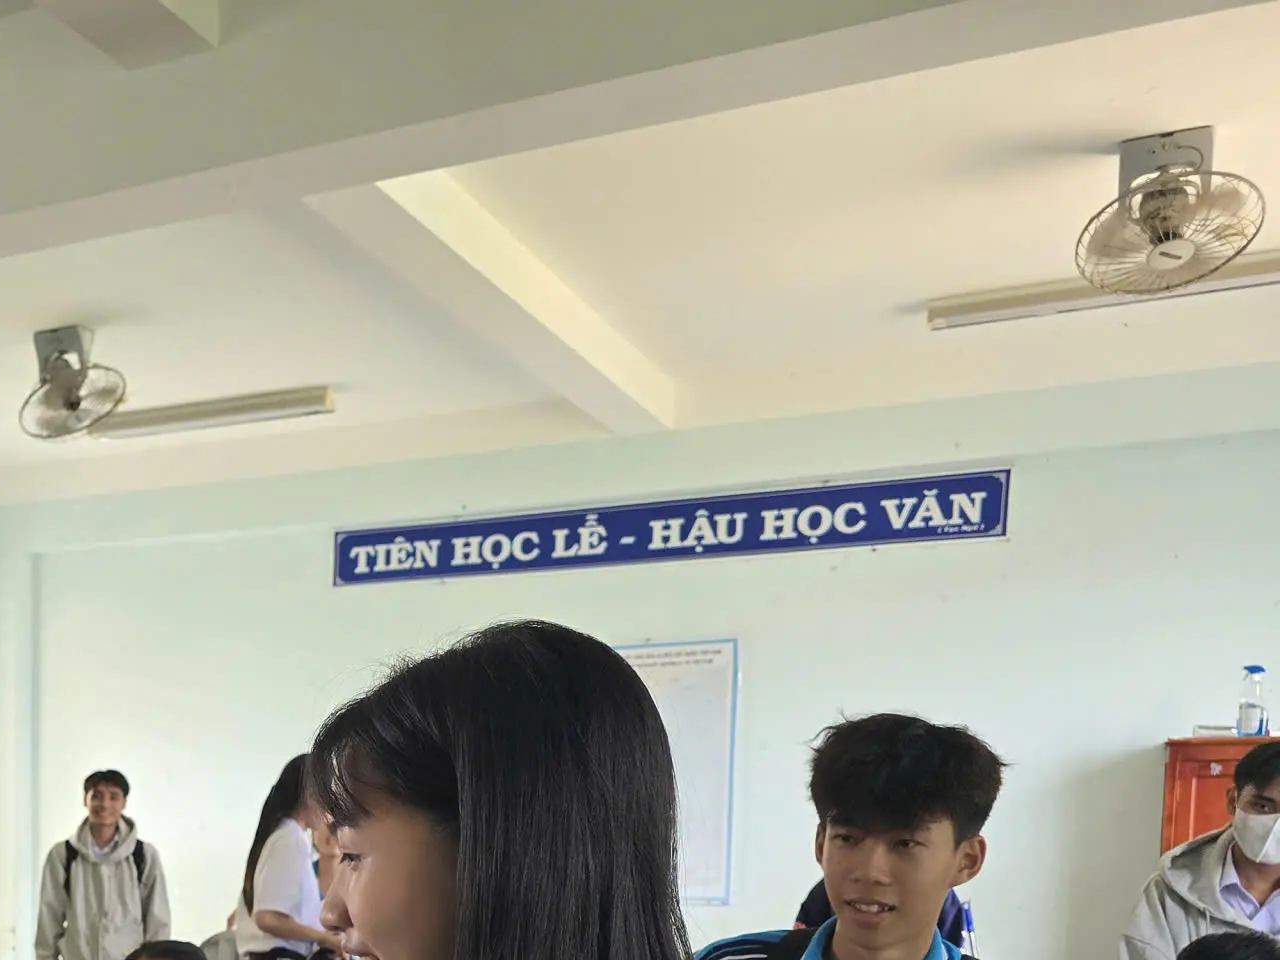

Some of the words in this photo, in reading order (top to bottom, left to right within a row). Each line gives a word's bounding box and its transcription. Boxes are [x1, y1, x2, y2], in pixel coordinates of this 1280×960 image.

[350, 536, 441, 574] TIÊN
[450, 531, 540, 569] HỌC
[551, 514, 608, 559] LỄ
[647, 508, 748, 553] HẬU
[759, 501, 867, 544] HỌC
[880, 489, 987, 531] VĂN
